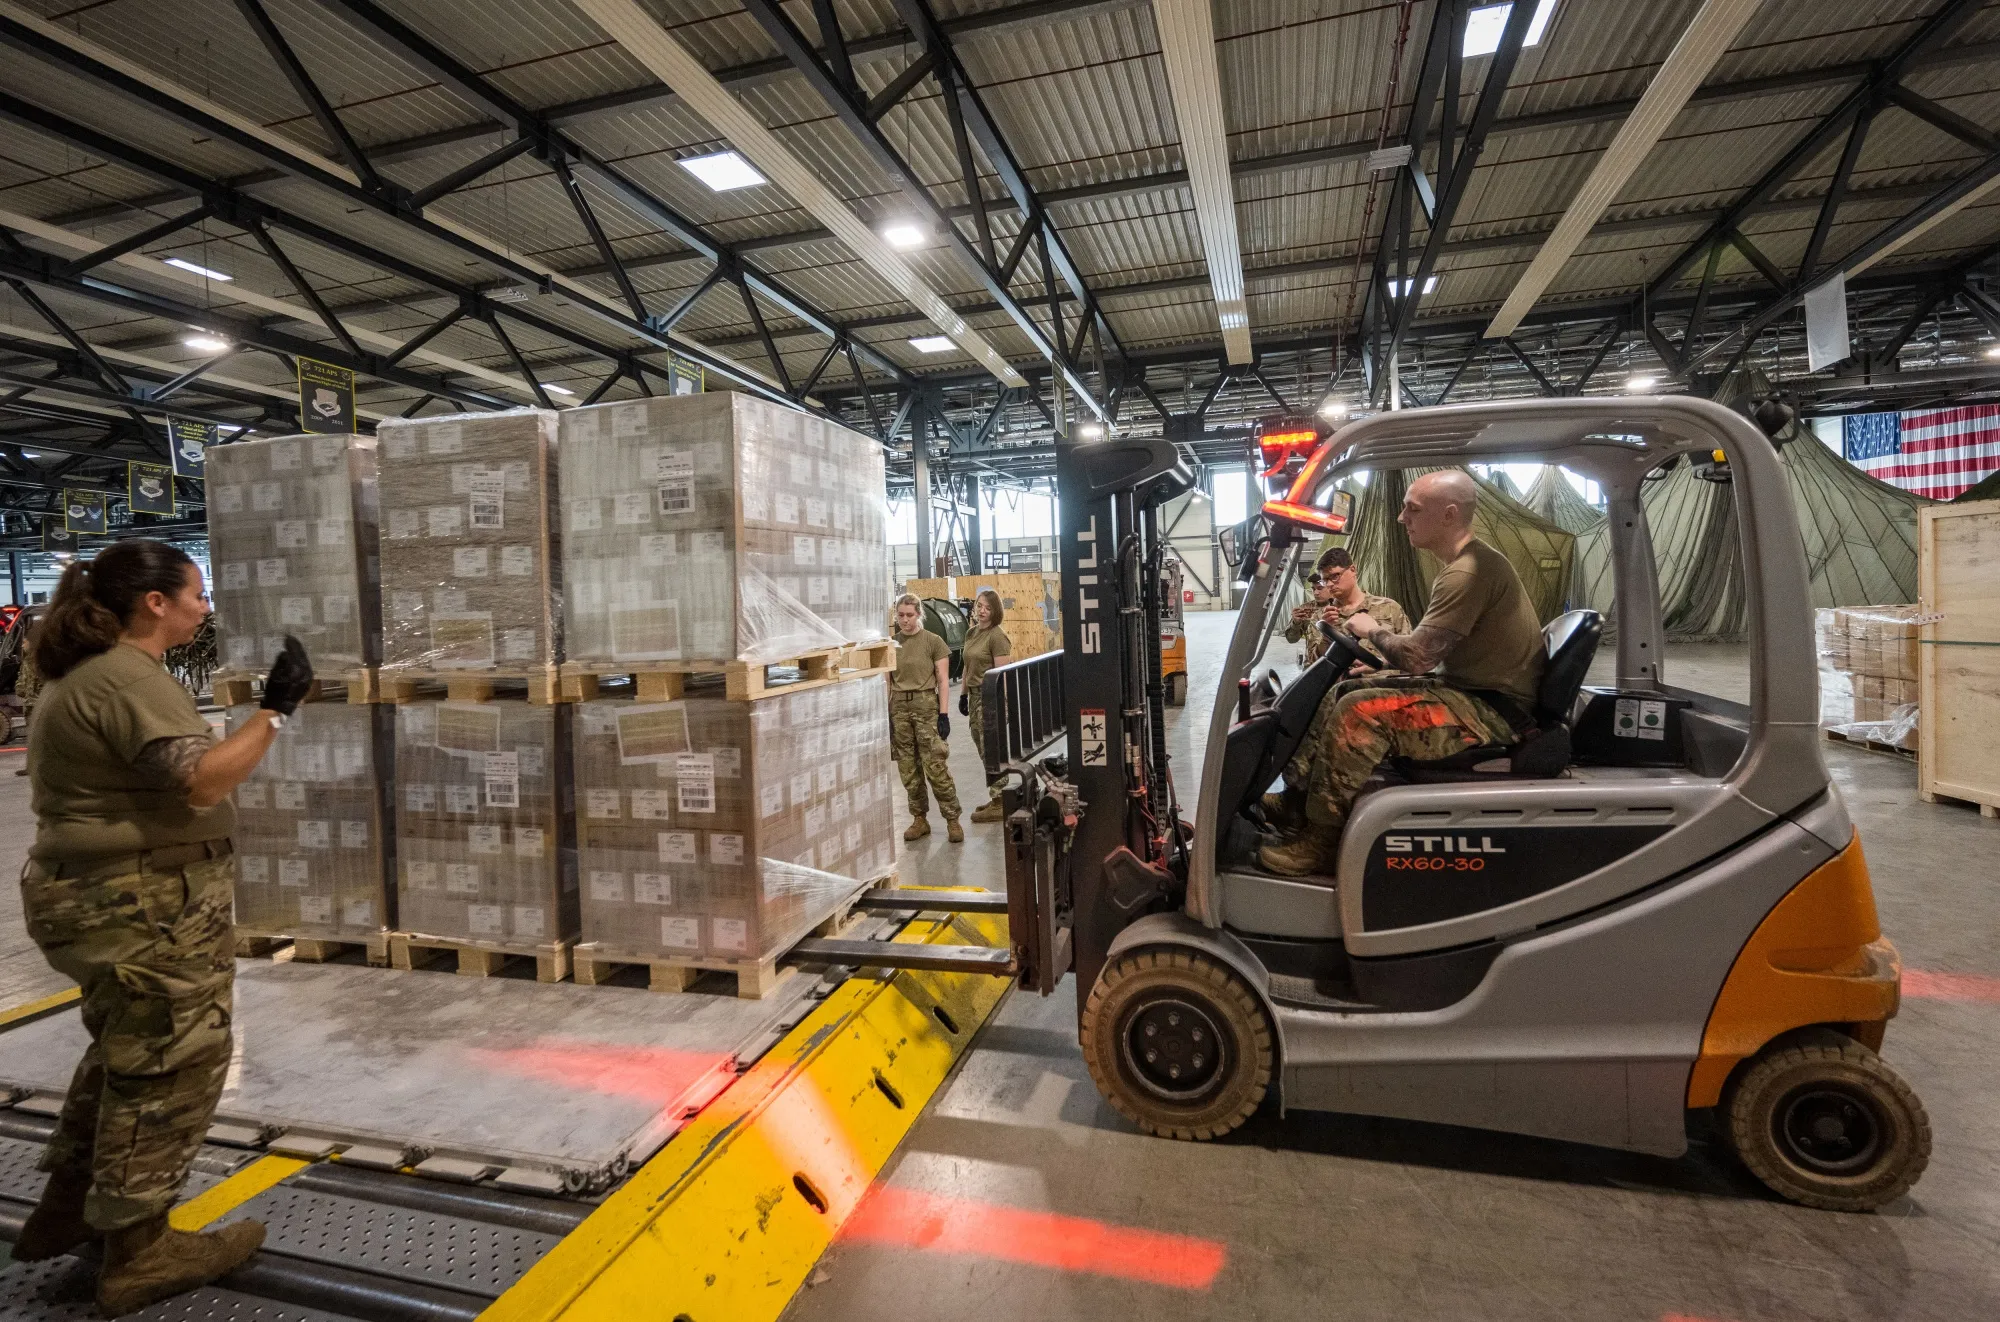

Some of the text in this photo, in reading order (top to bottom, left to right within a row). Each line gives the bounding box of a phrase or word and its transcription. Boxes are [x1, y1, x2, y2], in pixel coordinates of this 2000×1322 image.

[314, 365, 325, 373] 721
[1078, 515, 1100, 653] STILL
[1385, 836, 1506, 852] STILL
[1386, 857, 1485, 871] RX60-30
